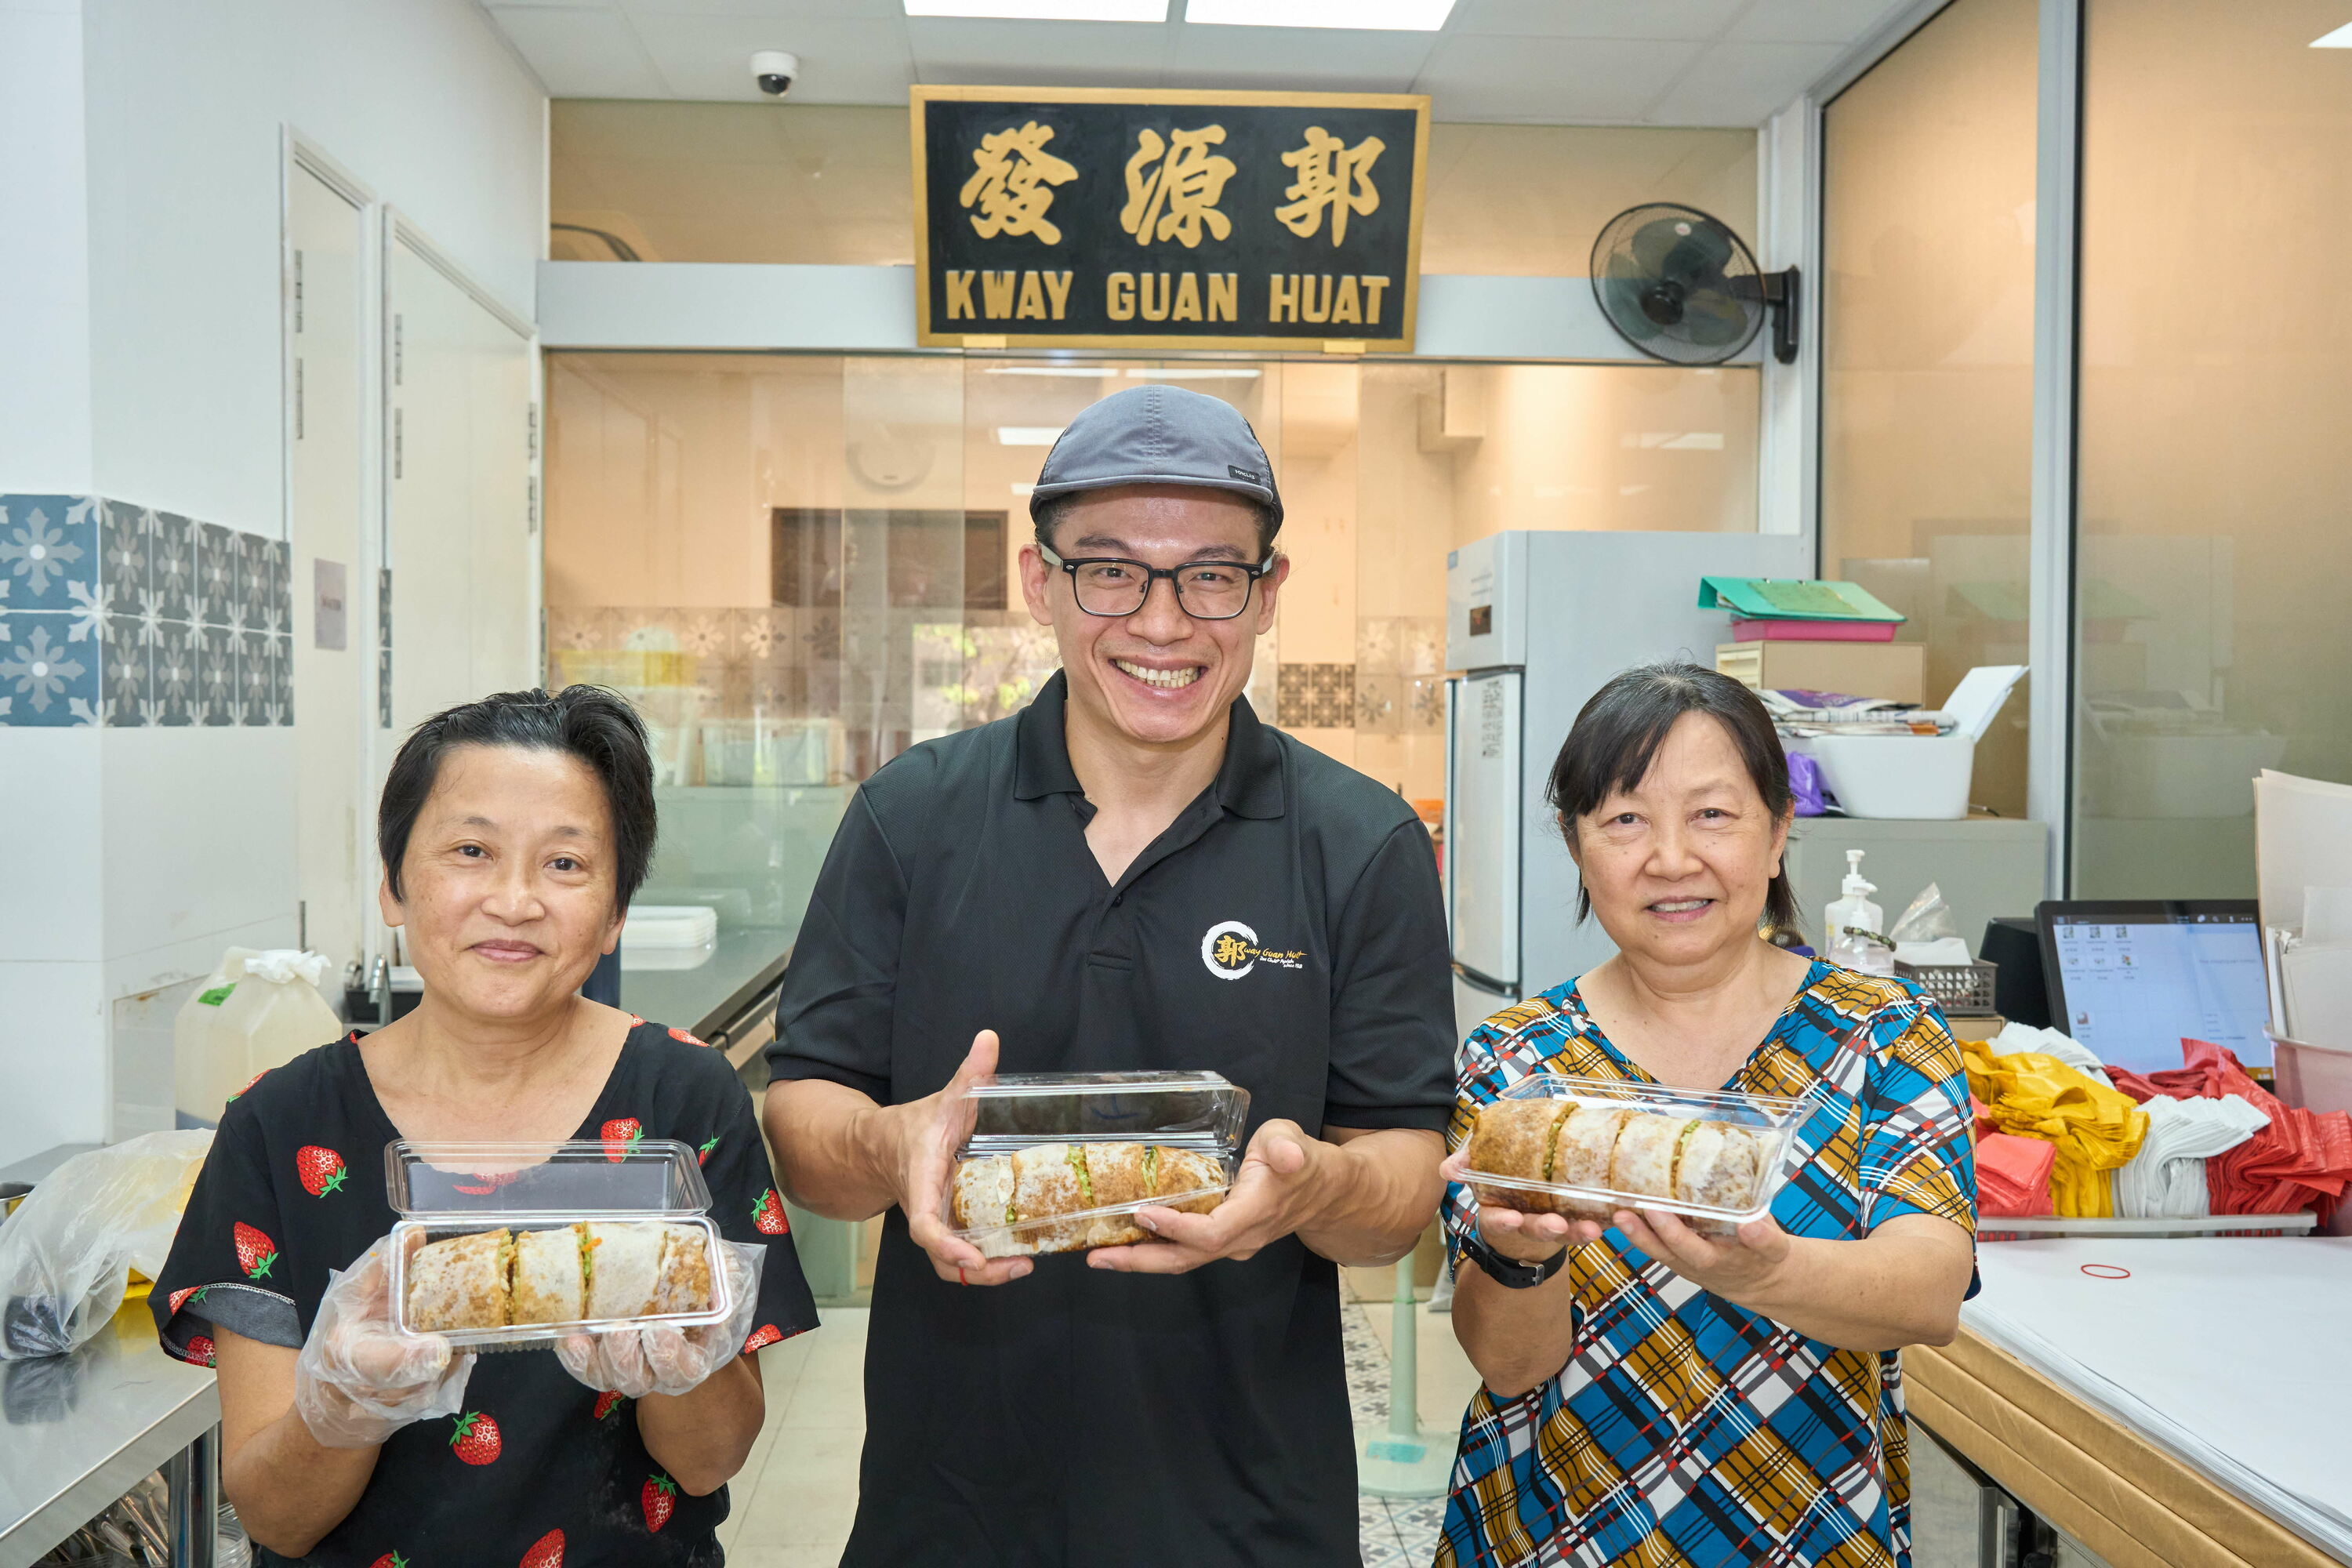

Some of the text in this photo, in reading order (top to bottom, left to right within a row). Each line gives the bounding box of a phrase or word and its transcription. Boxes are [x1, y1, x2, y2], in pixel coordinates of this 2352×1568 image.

[946, 270, 1390, 324] KWAY GUAN HUAT
[1262, 948, 1283, 959] Guan
